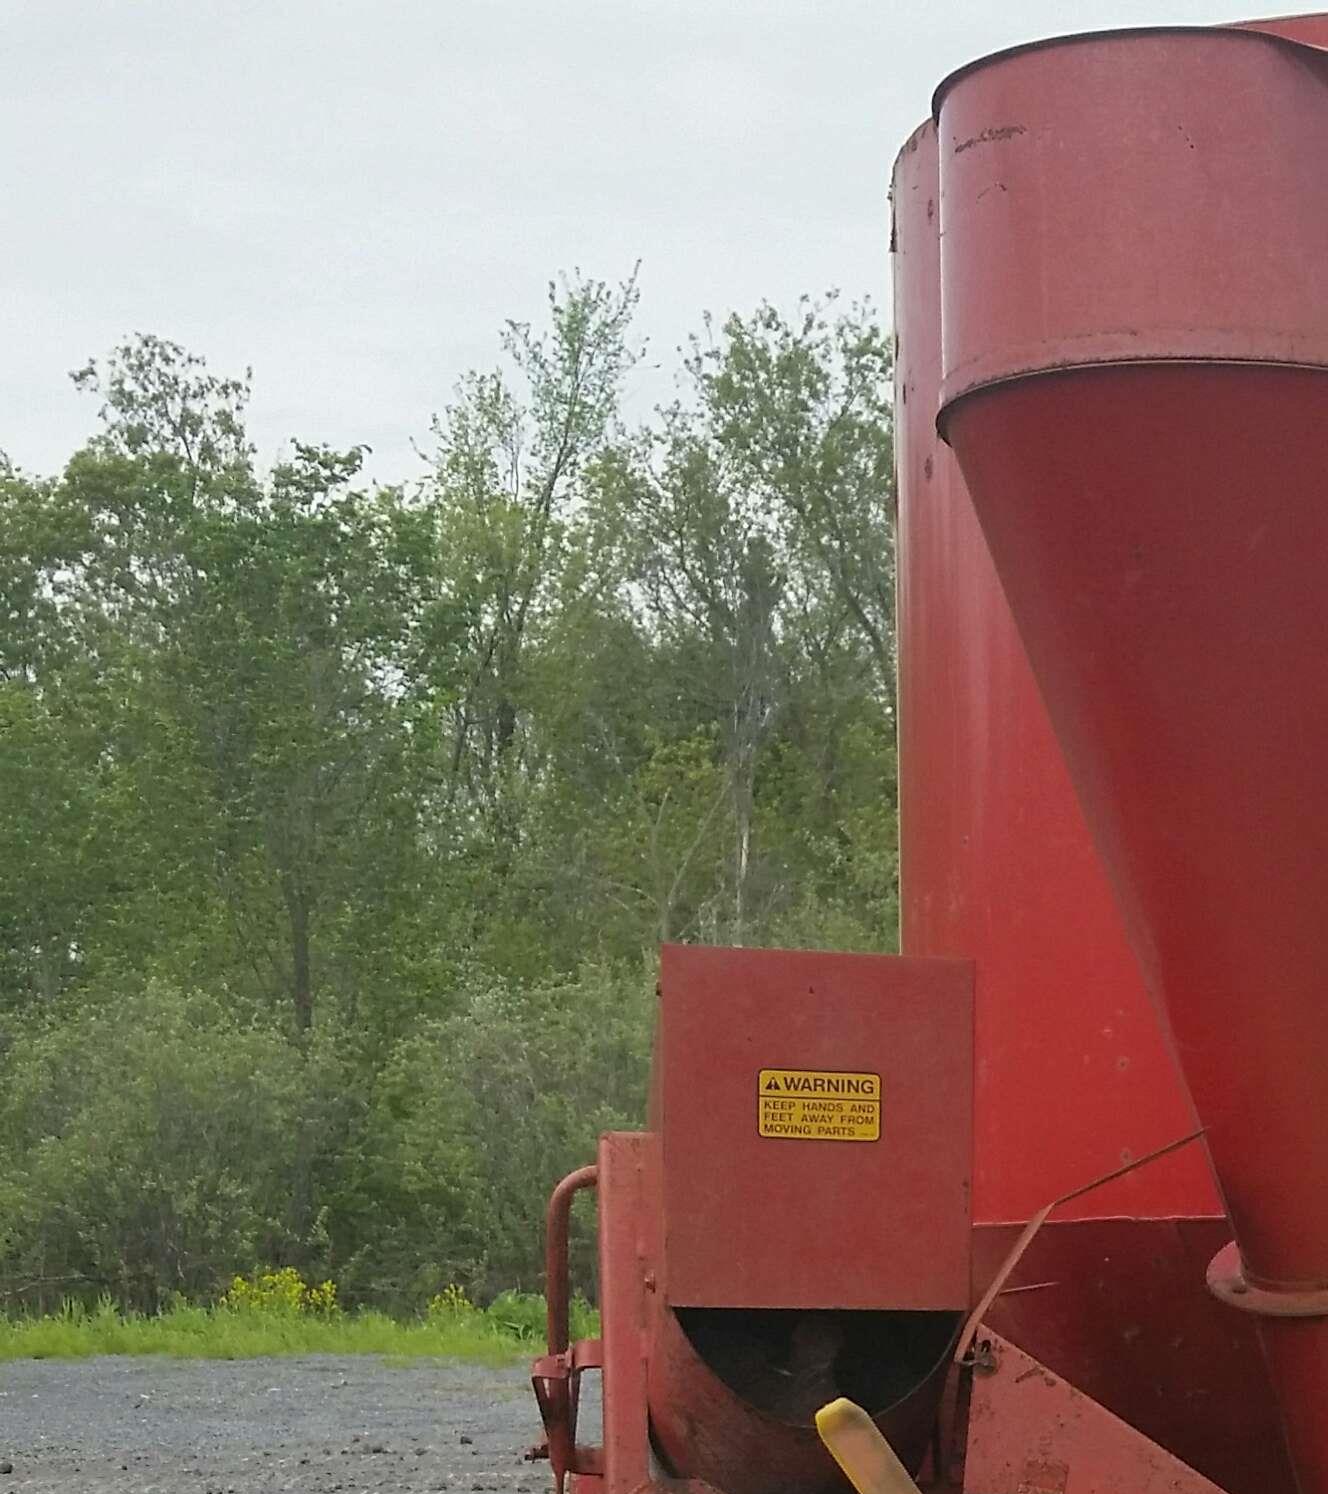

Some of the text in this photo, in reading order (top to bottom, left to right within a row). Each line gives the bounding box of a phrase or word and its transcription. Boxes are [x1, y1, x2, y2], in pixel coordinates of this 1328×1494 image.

[784, 1076, 874, 1094] WARNING
[764, 1100, 875, 1113] KEEP HANDS AND
[764, 1112, 874, 1125] FEET AWAY FROM
[764, 1123, 811, 1135] MOVING
[818, 1126, 855, 1136] PARTS
